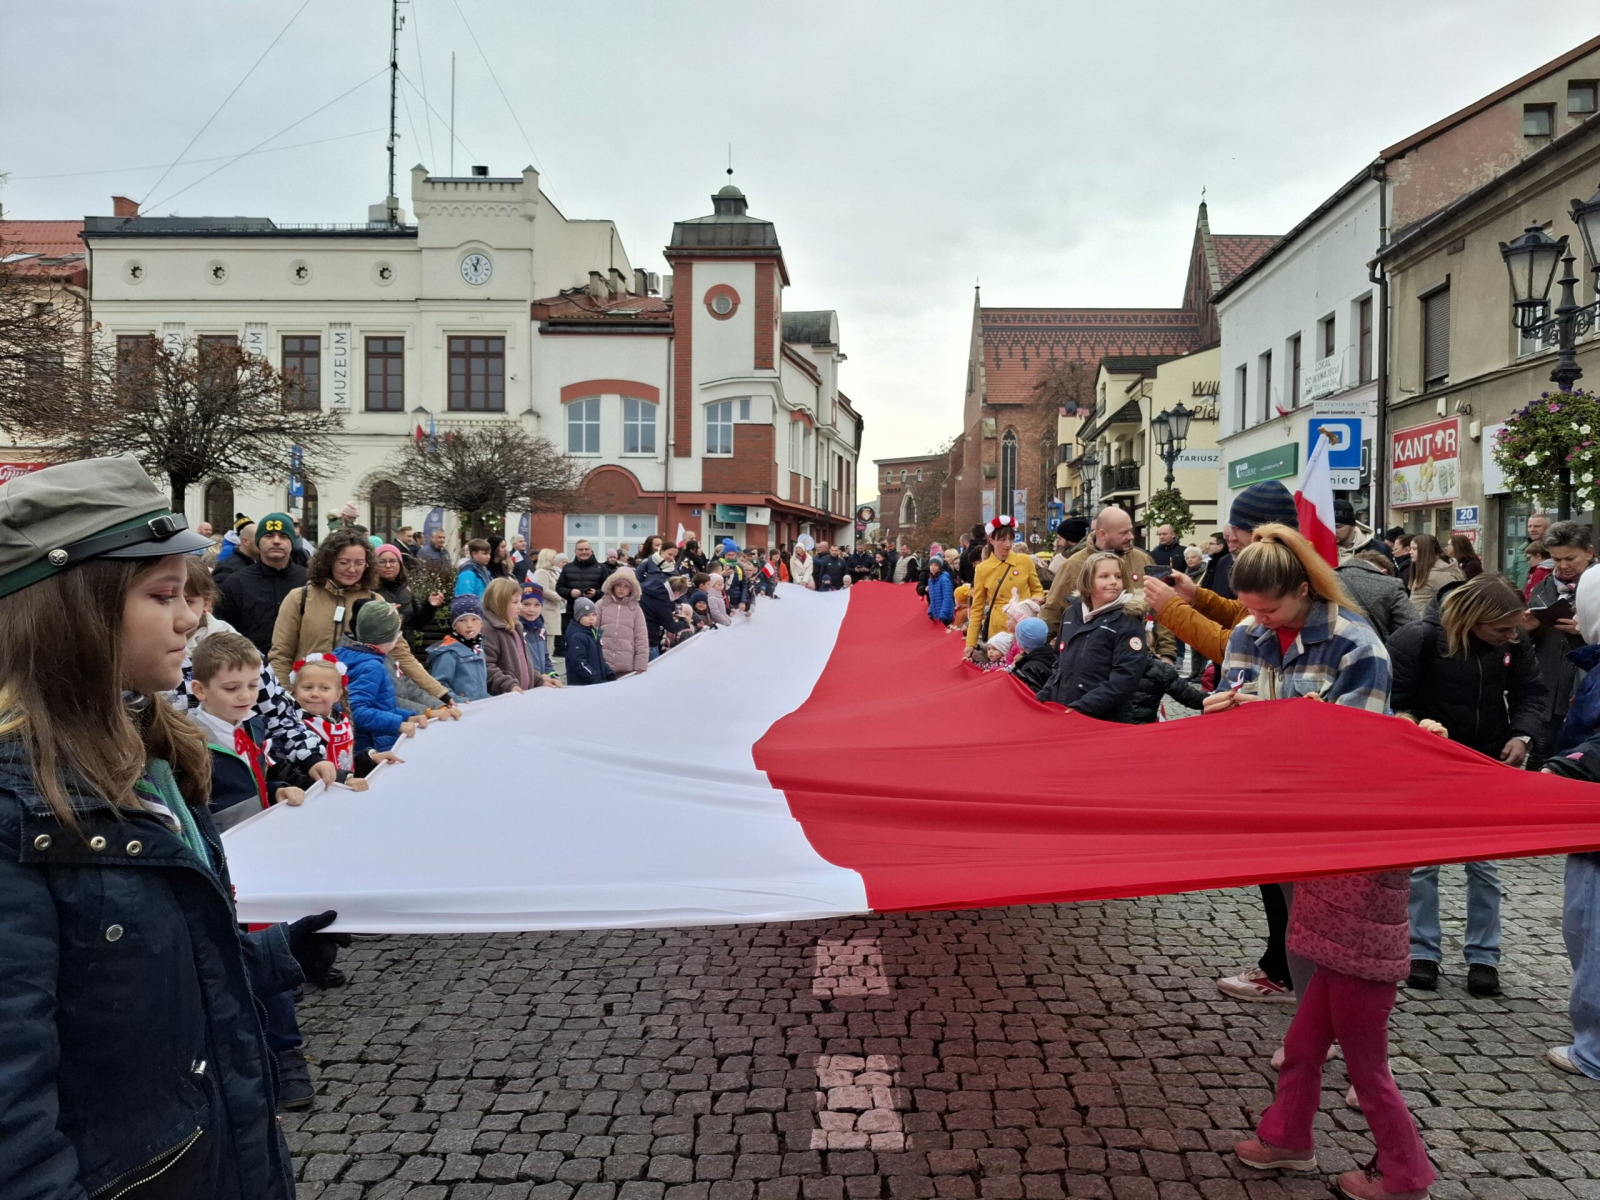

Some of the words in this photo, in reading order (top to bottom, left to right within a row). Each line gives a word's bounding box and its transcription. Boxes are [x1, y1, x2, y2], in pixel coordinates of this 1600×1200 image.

[334, 333, 347, 404] MUZEUM
[1394, 428, 1456, 462] KANTOR
[1331, 474, 1355, 485] niec
[1460, 508, 1474, 520] 20
